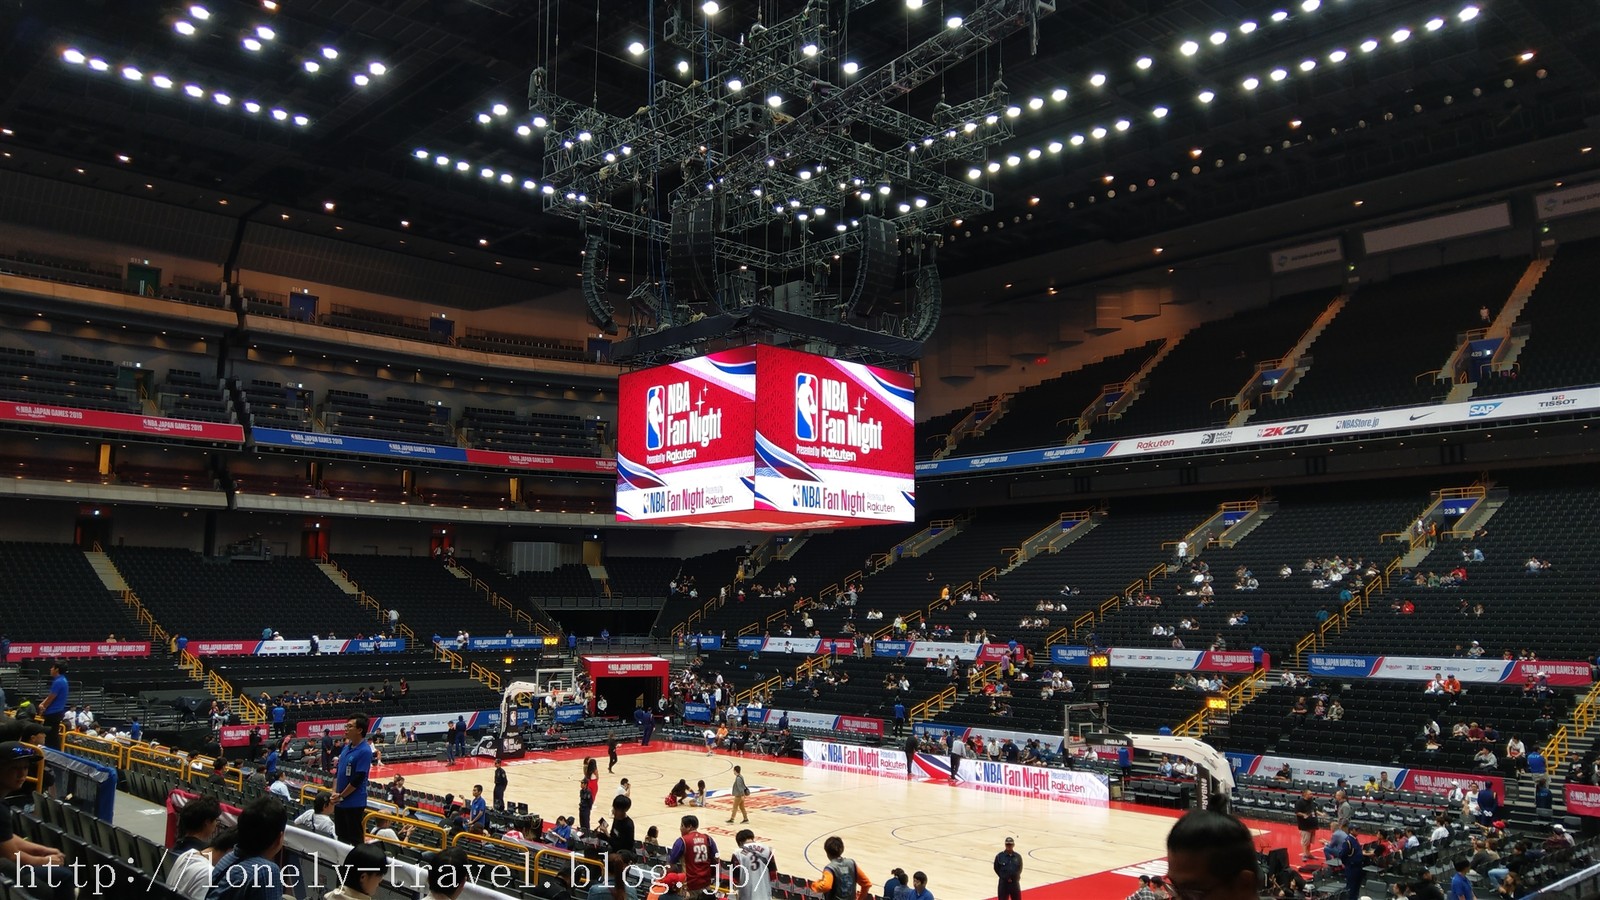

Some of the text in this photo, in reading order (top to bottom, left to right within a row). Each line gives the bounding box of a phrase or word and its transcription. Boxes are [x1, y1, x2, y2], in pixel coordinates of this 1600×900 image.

[668, 381, 690, 415] NBA
[822, 378, 848, 413] NBA
[1538, 398, 1577, 407] TISSOT
[21, 406, 32, 414] NBA
[33, 408, 52, 416] JAPAN
[52, 410, 69, 418] GAMES
[1470, 405, 1496, 416] SAP
[667, 408, 722, 448] Fan Night
[1342, 417, 1379, 429] NBAStore.jp
[822, 410, 882, 454] Fan Night
[1262, 424, 1309, 437] 2K20
[1136, 439, 1174, 450] Rakuten
[666, 448, 696, 462] Rakuten
[821, 446, 856, 462] Rakuten
[650, 491, 666, 514] NBA
[667, 490, 681, 512] Fan
[682, 487, 704, 514] Night
[706, 495, 734, 506] Rakuten
[802, 486, 896, 516] NBA Fan Night Rakuten
[1325, 658, 1339, 666] JAPAN
[1340, 659, 1354, 667] GAMES
[1354, 659, 1366, 668] 2019
[1526, 665, 1589, 676] NBA JAPAN GAMES 2019
[828, 744, 879, 772] NBA Fan Night
[881, 759, 906, 769] Rakuten
[984, 763, 1050, 794] NBA Fan Night
[1420, 776, 1431, 786] NBA
[1433, 776, 1452, 788] JAPAN
[1052, 781, 1085, 793] Rakuten
[1574, 791, 1587, 802] NBA
[693, 844, 708, 863] 23
[750, 852, 760, 871] 3
